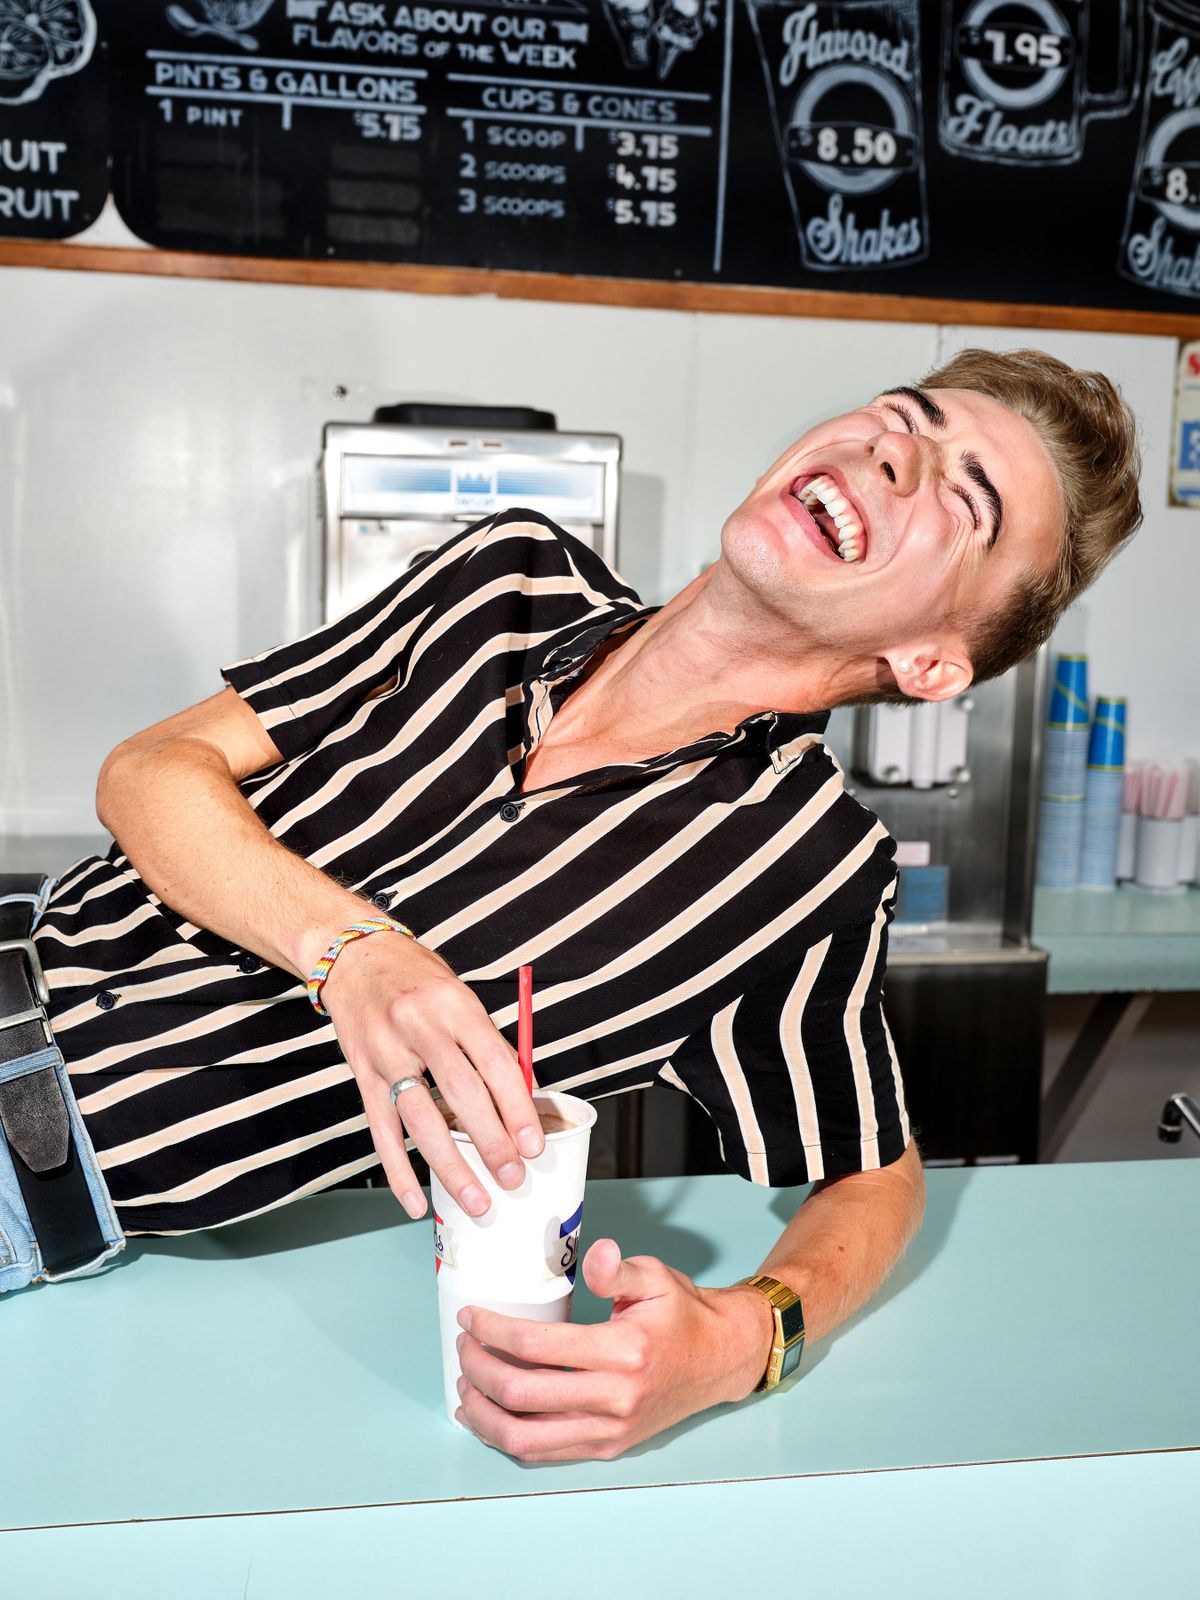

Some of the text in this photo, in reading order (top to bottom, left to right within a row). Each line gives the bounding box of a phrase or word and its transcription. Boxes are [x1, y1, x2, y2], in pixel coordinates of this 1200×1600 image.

[328, 1, 546, 41] ASK ABOUT OUR
[292, 24, 577, 69] FLAVORS OF THE WEEK
[779, 2, 912, 86] Flavored
[155, 61, 417, 103] PINTS & GALLONS
[159, 98, 244, 128] 1 PINT
[482, 86, 678, 123] CUPS & CONES
[949, 93, 1070, 154] Floats
[462, 118, 568, 149] 1 SCOOP
[459, 153, 568, 185] 2 SCOOPS
[457, 187, 567, 219] 3 SCOOPS
[806, 193, 922, 264] Shakes
